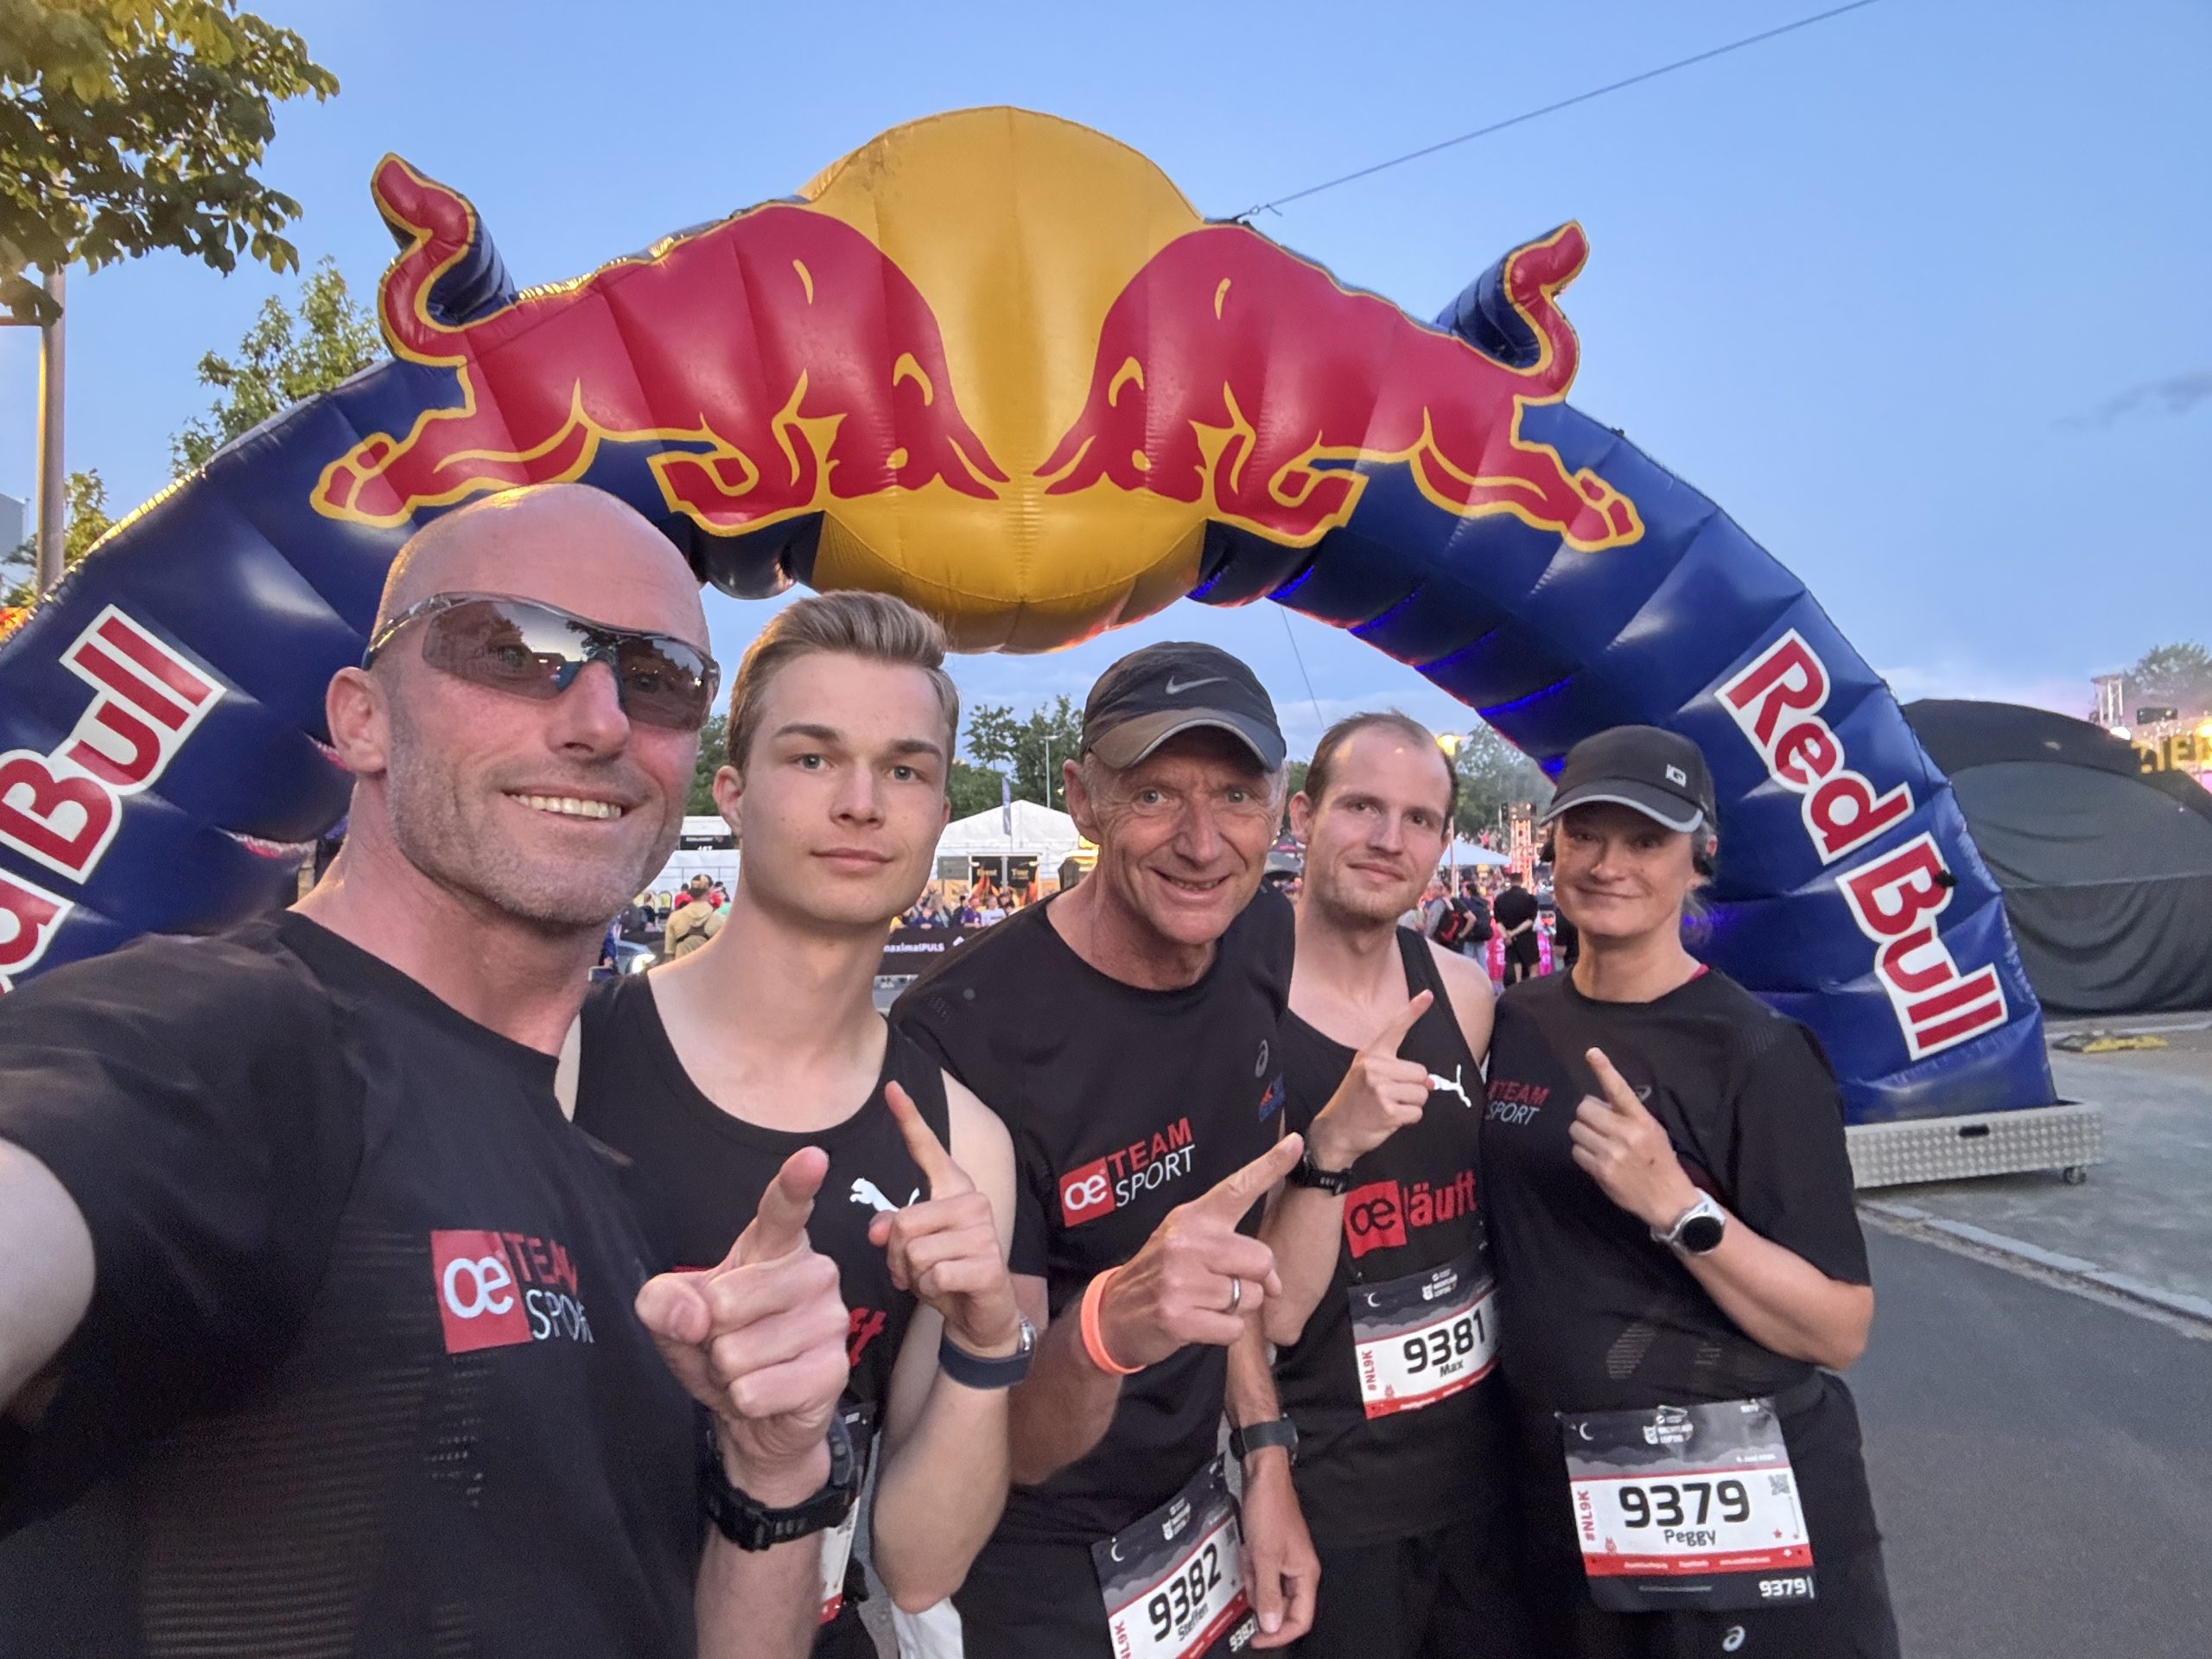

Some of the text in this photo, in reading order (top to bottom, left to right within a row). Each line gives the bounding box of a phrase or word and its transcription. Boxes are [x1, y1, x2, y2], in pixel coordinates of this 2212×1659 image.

[0, 610, 221, 878] Bull
[1719, 632, 2005, 1055] Red Bull
[1485, 1101, 1540, 1125] SPORT
[1491, 1080, 1549, 1107] TEAM
[1107, 1117, 1193, 1178] TEAM
[1116, 1144, 1195, 1207] SPORT
[1403, 1308, 1486, 1374] 9381
[1440, 1360, 1464, 1377] Max
[1577, 1491, 1596, 1541] #NL9K
[1619, 1480, 1750, 1528] 9379
[1664, 1529, 1715, 1547] Peggy
[1148, 1542, 1222, 1643] 9382
[1758, 1578, 1808, 1598] 9379
